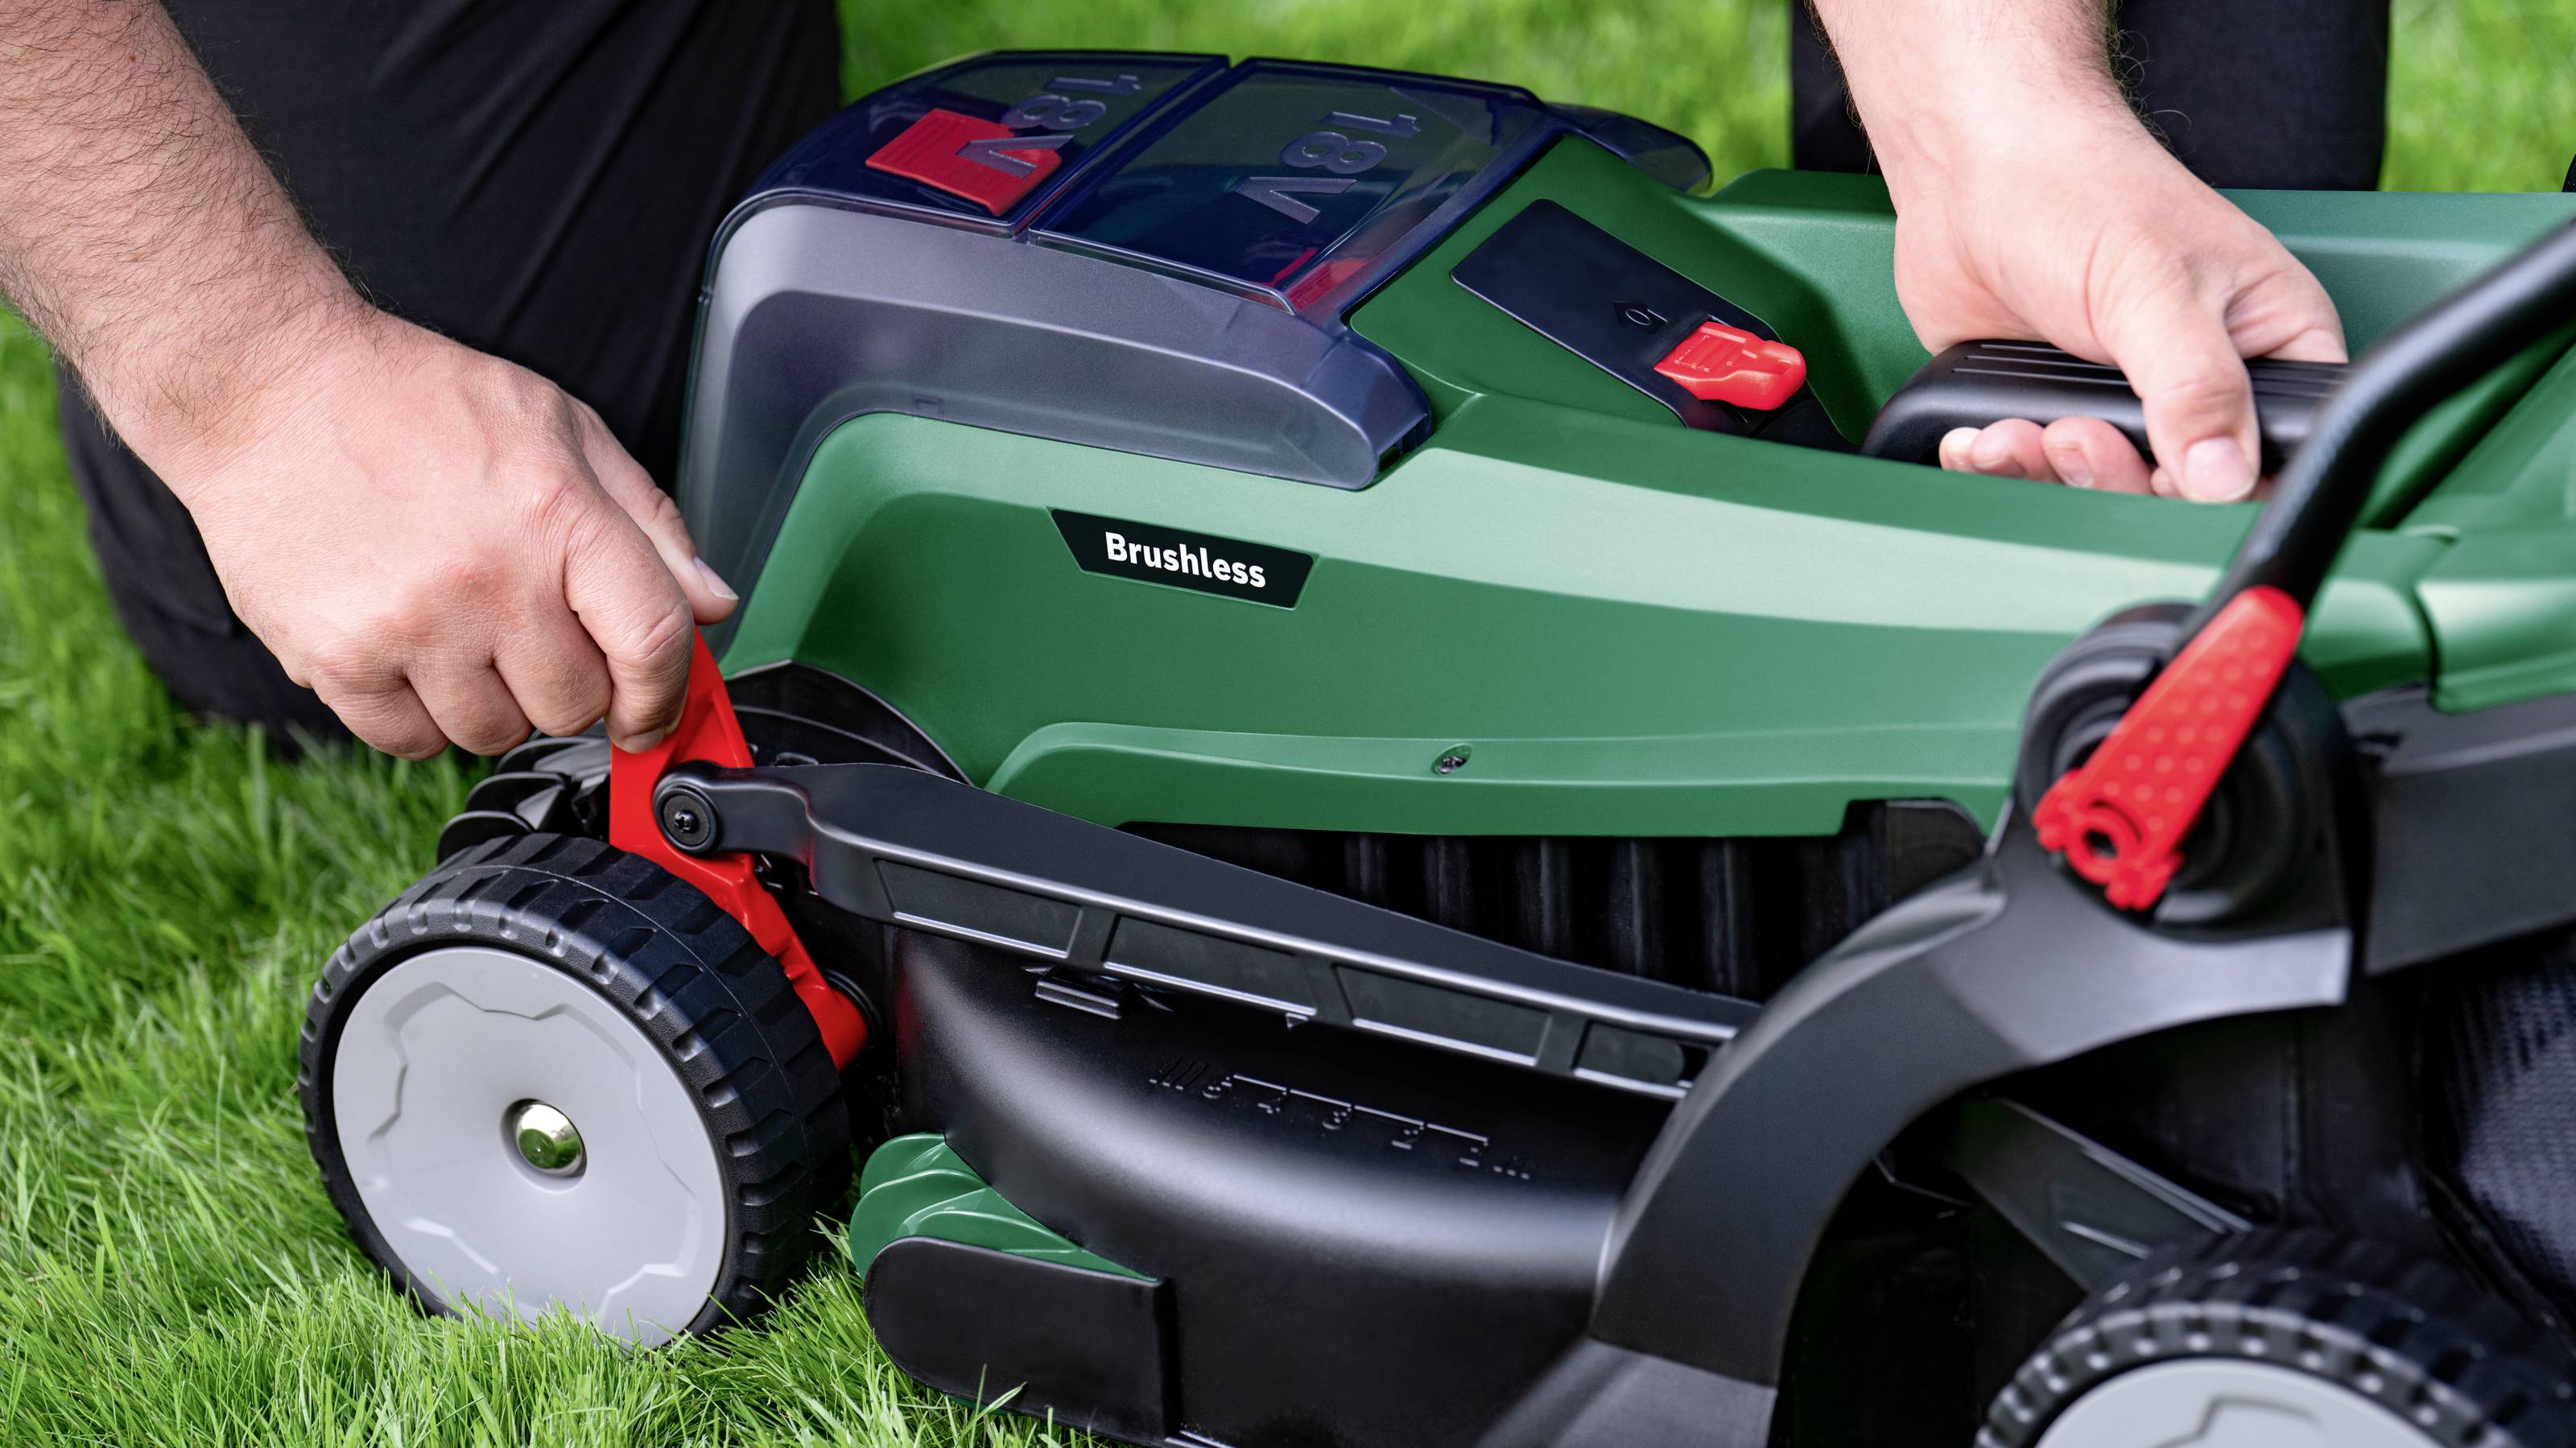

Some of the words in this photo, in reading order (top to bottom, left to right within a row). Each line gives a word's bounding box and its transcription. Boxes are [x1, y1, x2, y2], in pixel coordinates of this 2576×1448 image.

[956, 74, 1142, 179] 18V
[1234, 111, 1422, 225] 18V
[1104, 531, 1266, 588] Brushless
